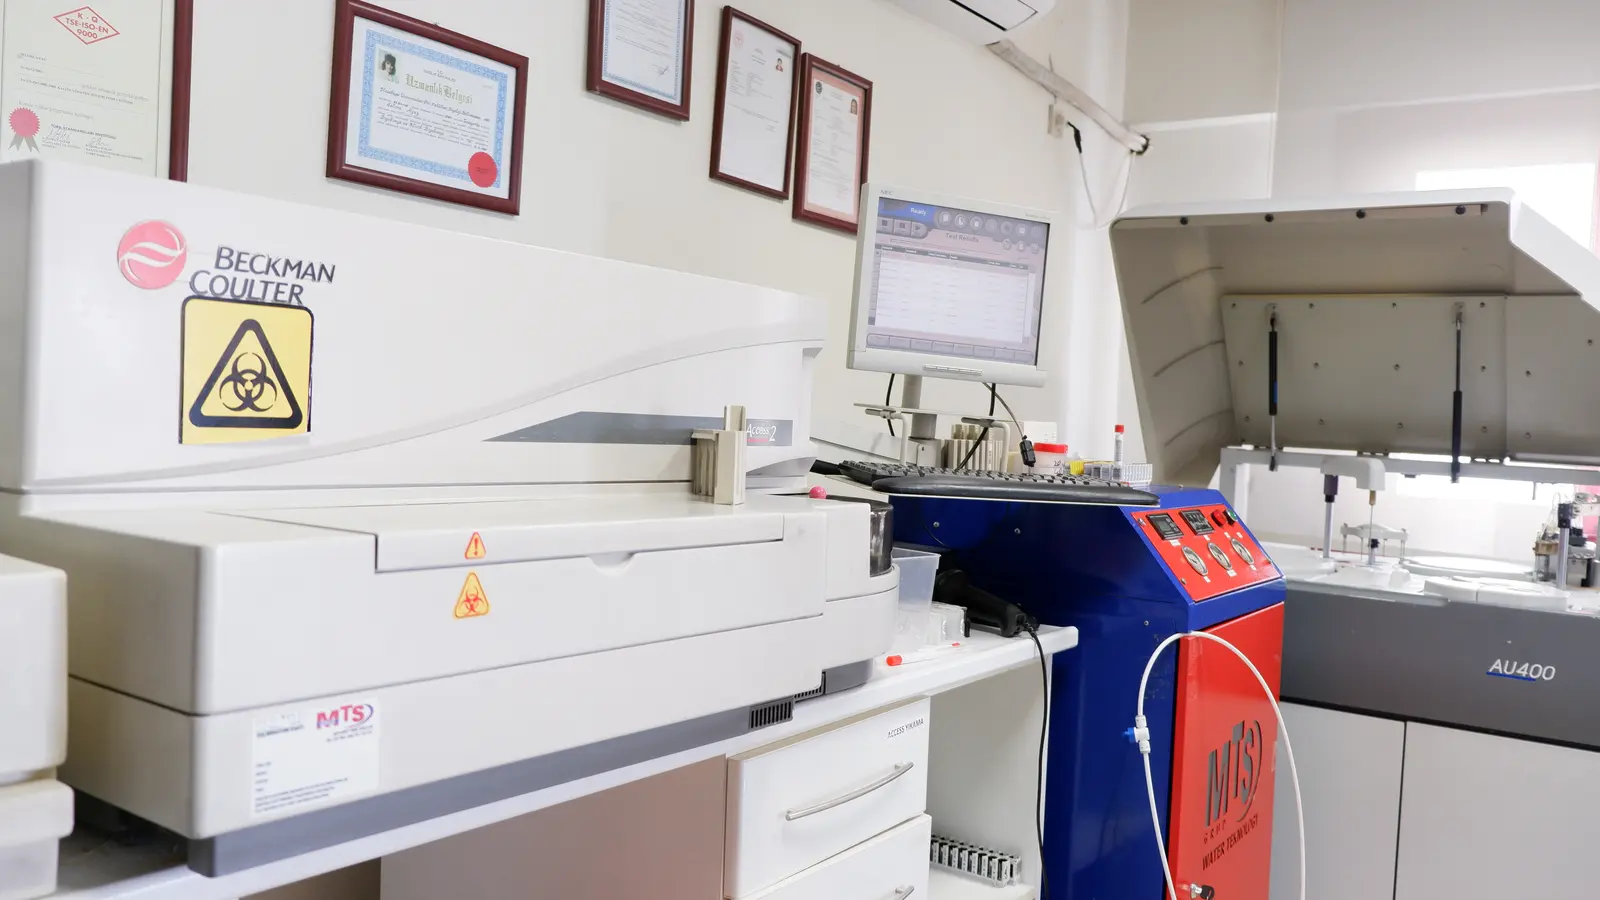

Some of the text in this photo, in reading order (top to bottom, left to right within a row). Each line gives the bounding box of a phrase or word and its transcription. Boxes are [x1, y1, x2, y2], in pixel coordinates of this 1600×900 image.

[65, 17, 109, 34] TSE-ISO-EN
[77, 12, 83, 20] K
[76, 28, 98, 39] 9000
[910, 207, 927, 216] Ready
[945, 232, 979, 243] Test Results
[214, 246, 336, 284] BECKMAN
[189, 269, 304, 304] COULTER
[1488, 658, 1556, 681] AU400
[316, 704, 365, 730] MTS
[887, 725, 905, 739] ACCESS
[1204, 720, 1255, 829] MTS
[1202, 841, 1225, 871] WATER
